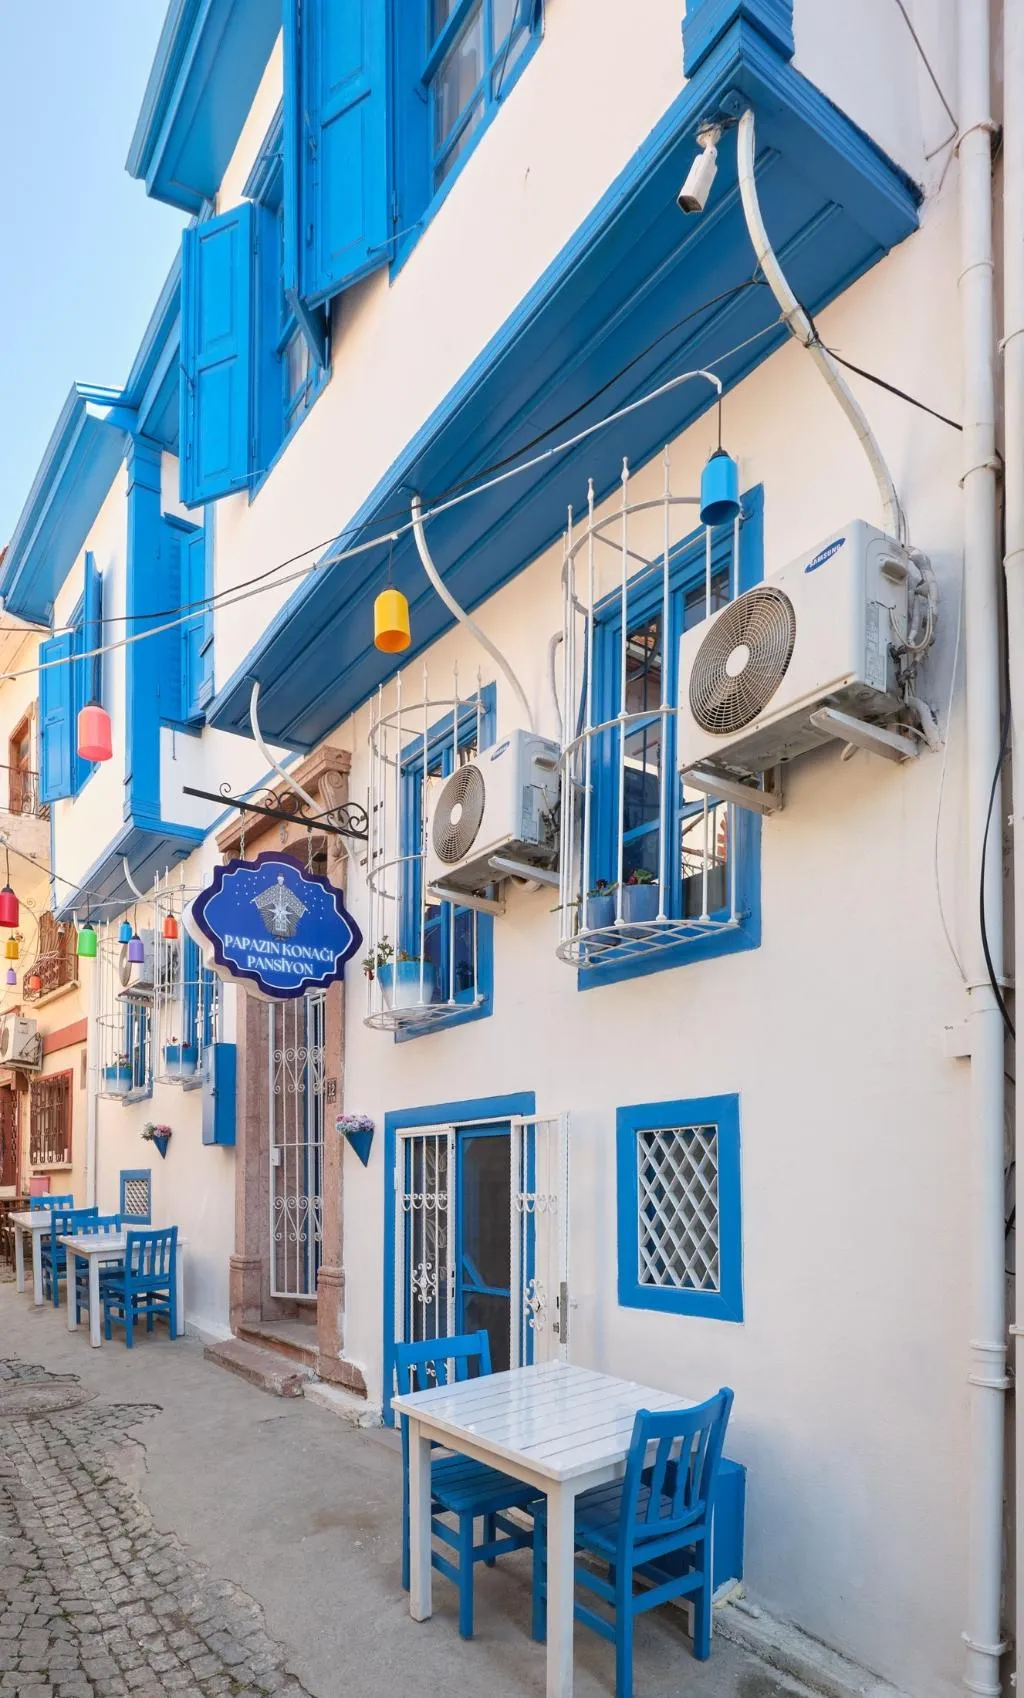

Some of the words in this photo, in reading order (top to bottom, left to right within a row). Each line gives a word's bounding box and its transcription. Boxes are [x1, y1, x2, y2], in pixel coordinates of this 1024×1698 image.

[224, 934, 280, 954] PAPAZIN
[282, 943, 334, 962] KONAĞI
[247, 955, 314, 975] PANSİYON
